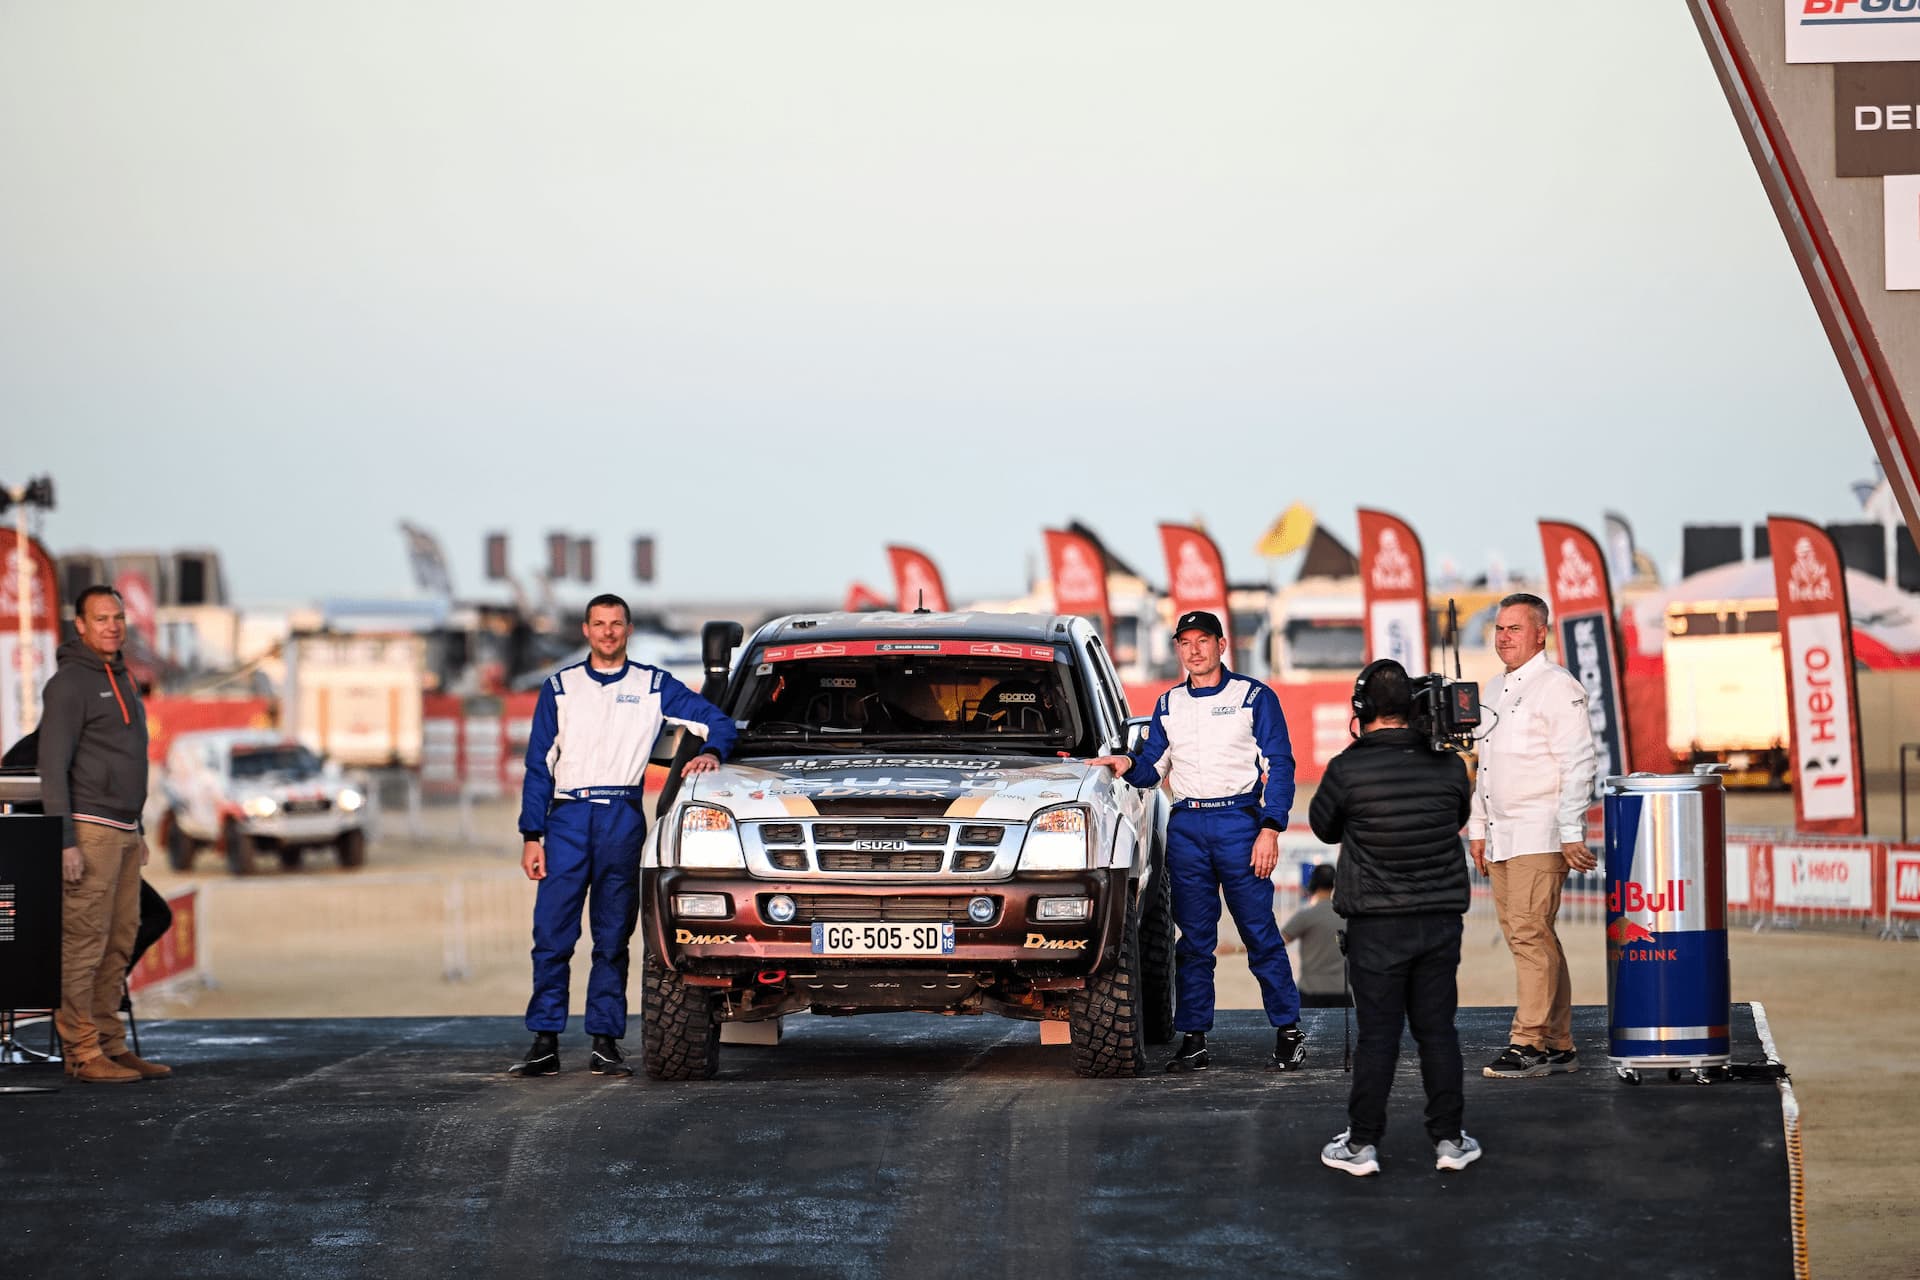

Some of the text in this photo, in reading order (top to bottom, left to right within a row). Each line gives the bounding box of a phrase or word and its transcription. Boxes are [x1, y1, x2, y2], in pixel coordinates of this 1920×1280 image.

[1855, 104, 1920, 131] DE
[820, 678, 856, 688] sparco
[999, 693, 1036, 702] sparco
[1804, 647, 1836, 744] Hero
[858, 841, 902, 850] ISUZU
[828, 927, 938, 949] GG-505-SD
[944, 938, 953, 949] 16
[1629, 949, 1678, 961] DRINK
